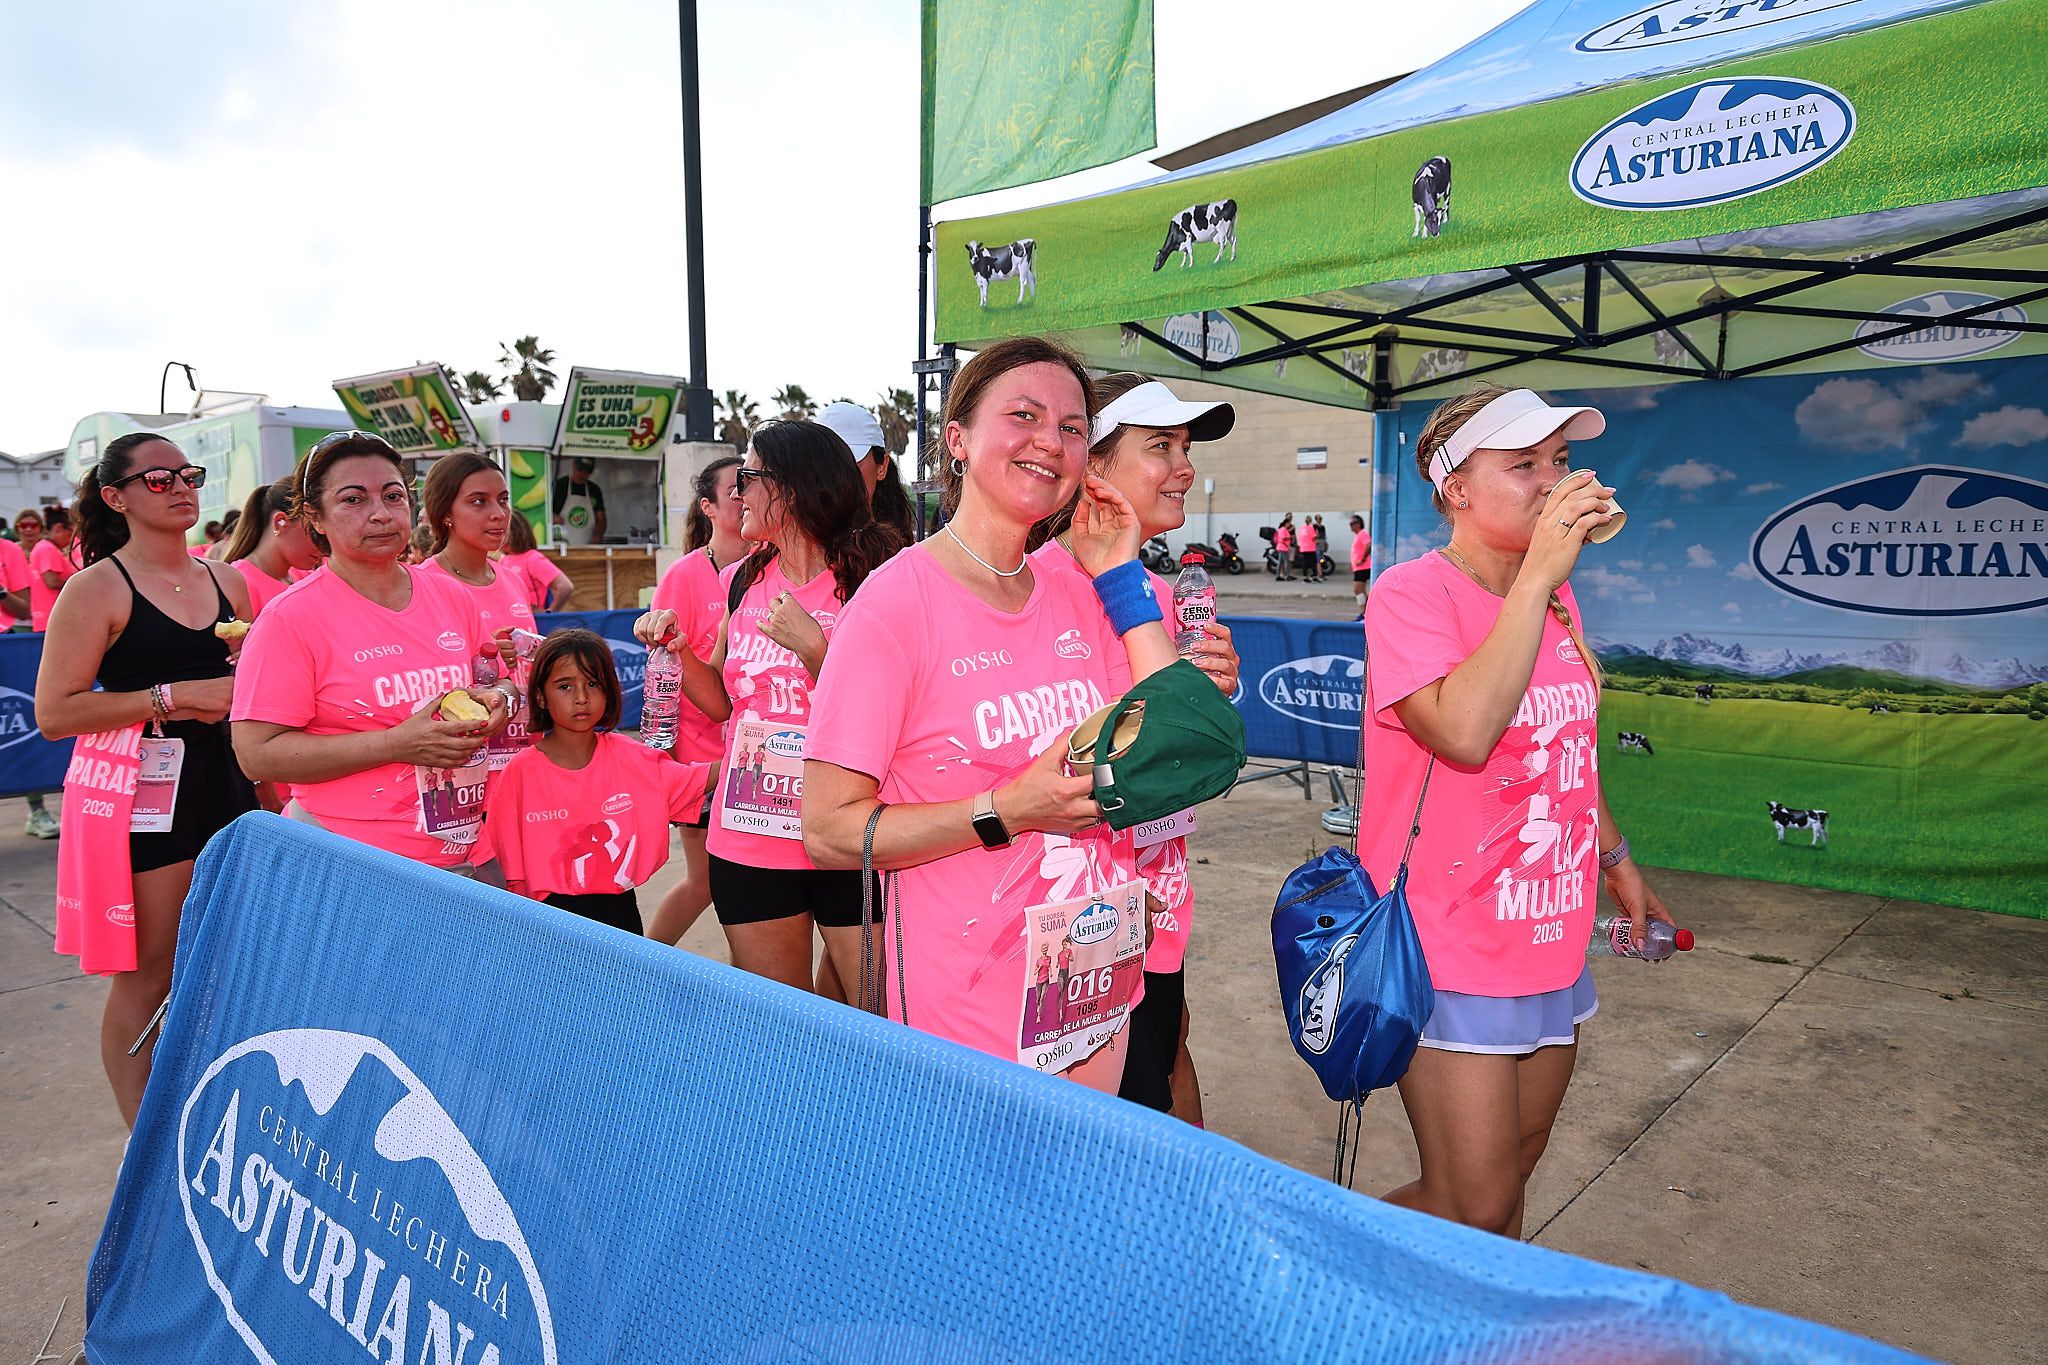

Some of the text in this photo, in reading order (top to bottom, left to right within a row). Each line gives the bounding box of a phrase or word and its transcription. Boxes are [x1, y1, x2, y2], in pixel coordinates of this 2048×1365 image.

[1632, 102, 1820, 148] CENTRAL LECHERA
[1590, 120, 1828, 189] ASTURIANA
[582, 384, 635, 396] CUIDARSE
[578, 397, 633, 413] ES UNA
[576, 414, 638, 429] GOZADA
[1832, 520, 1943, 534] CENTRAL
[1182, 606, 1209, 615] ZERO
[1182, 613, 1210, 622] SODIO
[354, 644, 403, 663] OYSHO
[951, 649, 1013, 677] OYSHO
[1294, 677, 1347, 689] CENTRAL
[769, 676, 806, 715] DE
[1509, 681, 1597, 728] ARRERA
[973, 678, 1105, 750] CARRERA
[507, 723, 531, 737] 01
[744, 730, 764, 738] SUMA
[1558, 735, 1586, 793] DE
[457, 783, 485, 805] 016
[762, 774, 803, 796] 016
[82, 799, 115, 818] 2026
[734, 802, 758, 811] CARRERA
[769, 806, 776, 814] LA
[776, 807, 797, 816] MUJER
[772, 797, 792, 807] 1491
[526, 808, 568, 822] OYSHO
[733, 815, 769, 827] OYSHO
[1137, 818, 1175, 838] OYSHO
[1553, 821, 1574, 875] LA
[1496, 871, 1583, 921] MUJER
[1040, 918, 1067, 933] SUMA
[1047, 911, 1066, 920] DORSAL
[1074, 917, 1117, 939] ASTURIANA
[1532, 920, 1563, 945] 2026
[1622, 919, 1632, 945] ZERO
[1067, 966, 1113, 1002] 016
[1076, 1000, 1098, 1016] 1095
[1063, 1024, 1071, 1033] DE
[1072, 1021, 1080, 1029] LA
[1081, 1013, 1101, 1027] MUJER
[1037, 1041, 1073, 1066] OYSHO
[259, 1105, 509, 1320] CENTRAL LECHERA
